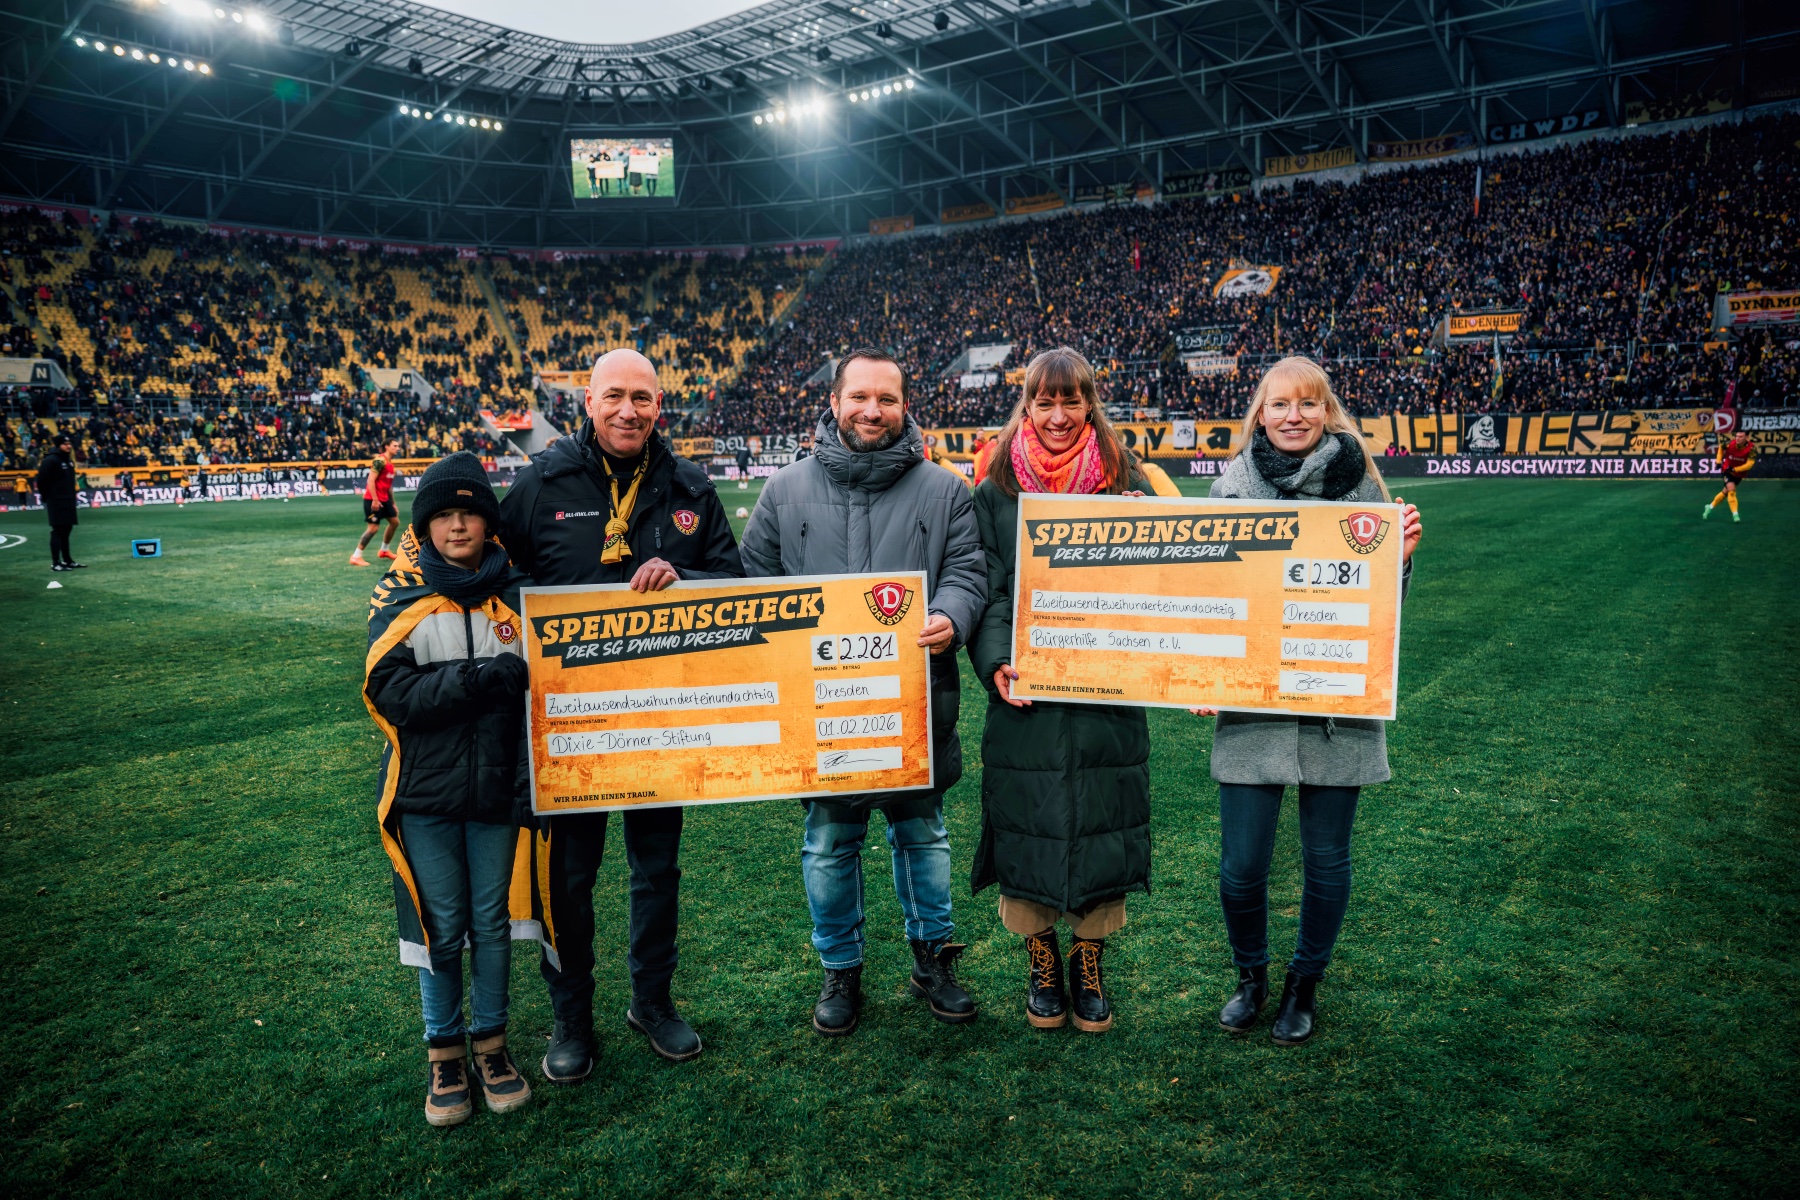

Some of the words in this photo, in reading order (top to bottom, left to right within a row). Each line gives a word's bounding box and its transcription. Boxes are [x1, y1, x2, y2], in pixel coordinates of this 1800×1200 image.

[35, 366, 48, 380] N
[401, 373, 412, 387] M
[1189, 461, 1215, 475] NIE
[1426, 459, 1471, 475] DASS
[1474, 459, 1587, 475] AUSCHWITZ
[1590, 458, 1625, 474] NIE
[1629, 458, 1693, 474] MEHR
[1698, 458, 1725, 474] SE
[1033, 516, 1298, 546] SPENDENSCHECK
[1352, 514, 1376, 538] D
[1053, 547, 1085, 561] DER
[1087, 546, 1107, 560] SG
[1109, 545, 1159, 561] DYNAMO
[1161, 543, 1229, 558] DRESDEN
[1344, 532, 1384, 554] DRESDEN
[877, 584, 901, 609] D
[541, 592, 823, 645] SPENDENSCHECK
[870, 603, 909, 625] DRESDEN
[1283, 603, 1338, 622] Dresden
[566, 642, 598, 660] DER
[602, 639, 624, 657] SG
[627, 634, 681, 654] DYNAMO
[682, 625, 754, 647] DRESDEN
[839, 634, 895, 661] 2.281
[1031, 628, 1098, 649] Bürgerhilfe
[1108, 631, 1151, 648] Sachsen
[1283, 641, 1353, 659] 01.02.2026
[815, 683, 870, 699] Dresden
[1029, 683, 1045, 691] WIR
[1045, 684, 1071, 692] HABEN
[1072, 685, 1095, 693] EINEN
[1096, 686, 1125, 695] TRAUM.
[818, 714, 896, 737] 01.02.2026
[553, 796, 570, 804] WIR
[571, 794, 600, 803] HABEN
[600, 791, 626, 801] EINEN
[626, 790, 658, 799] TRAUM.
